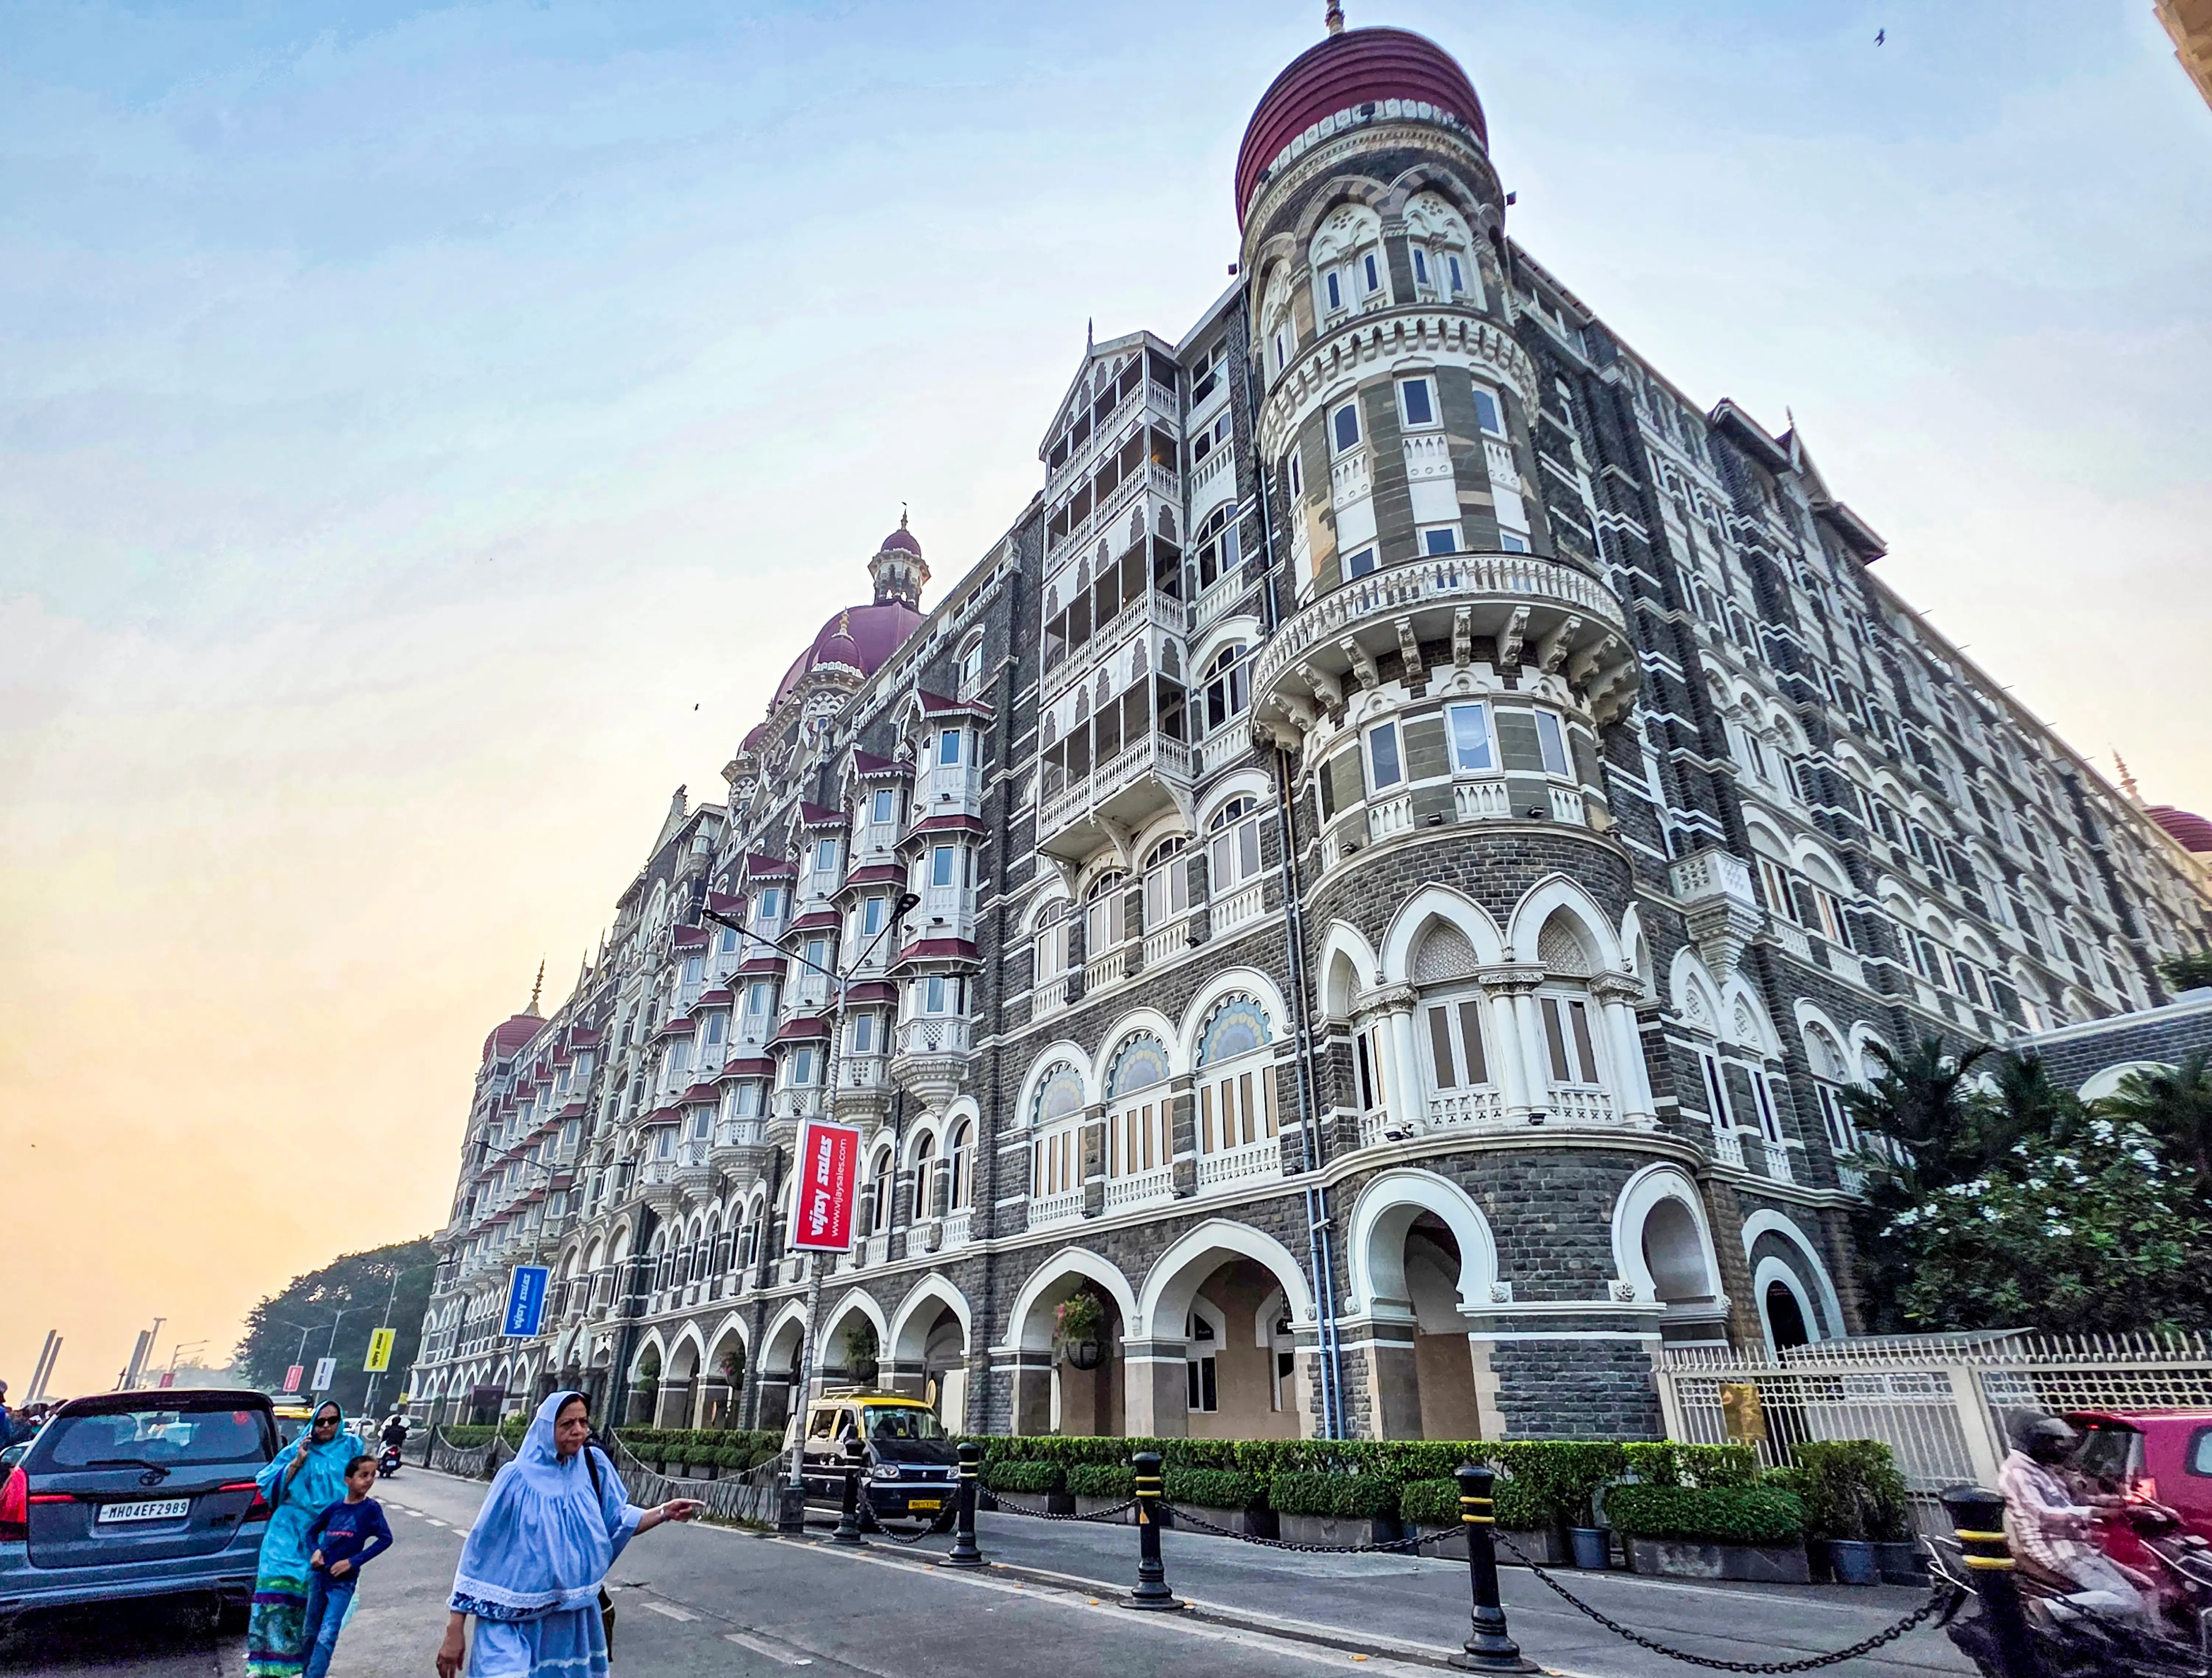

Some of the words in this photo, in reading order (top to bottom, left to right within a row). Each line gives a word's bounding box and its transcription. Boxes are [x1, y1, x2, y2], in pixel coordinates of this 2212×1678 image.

[817, 1135, 832, 1186] sales
[832, 1138, 847, 1237] www.vijaysales.com
[809, 1189, 830, 1236] vijay
[108, 1502, 187, 1518] MH04EF2989
